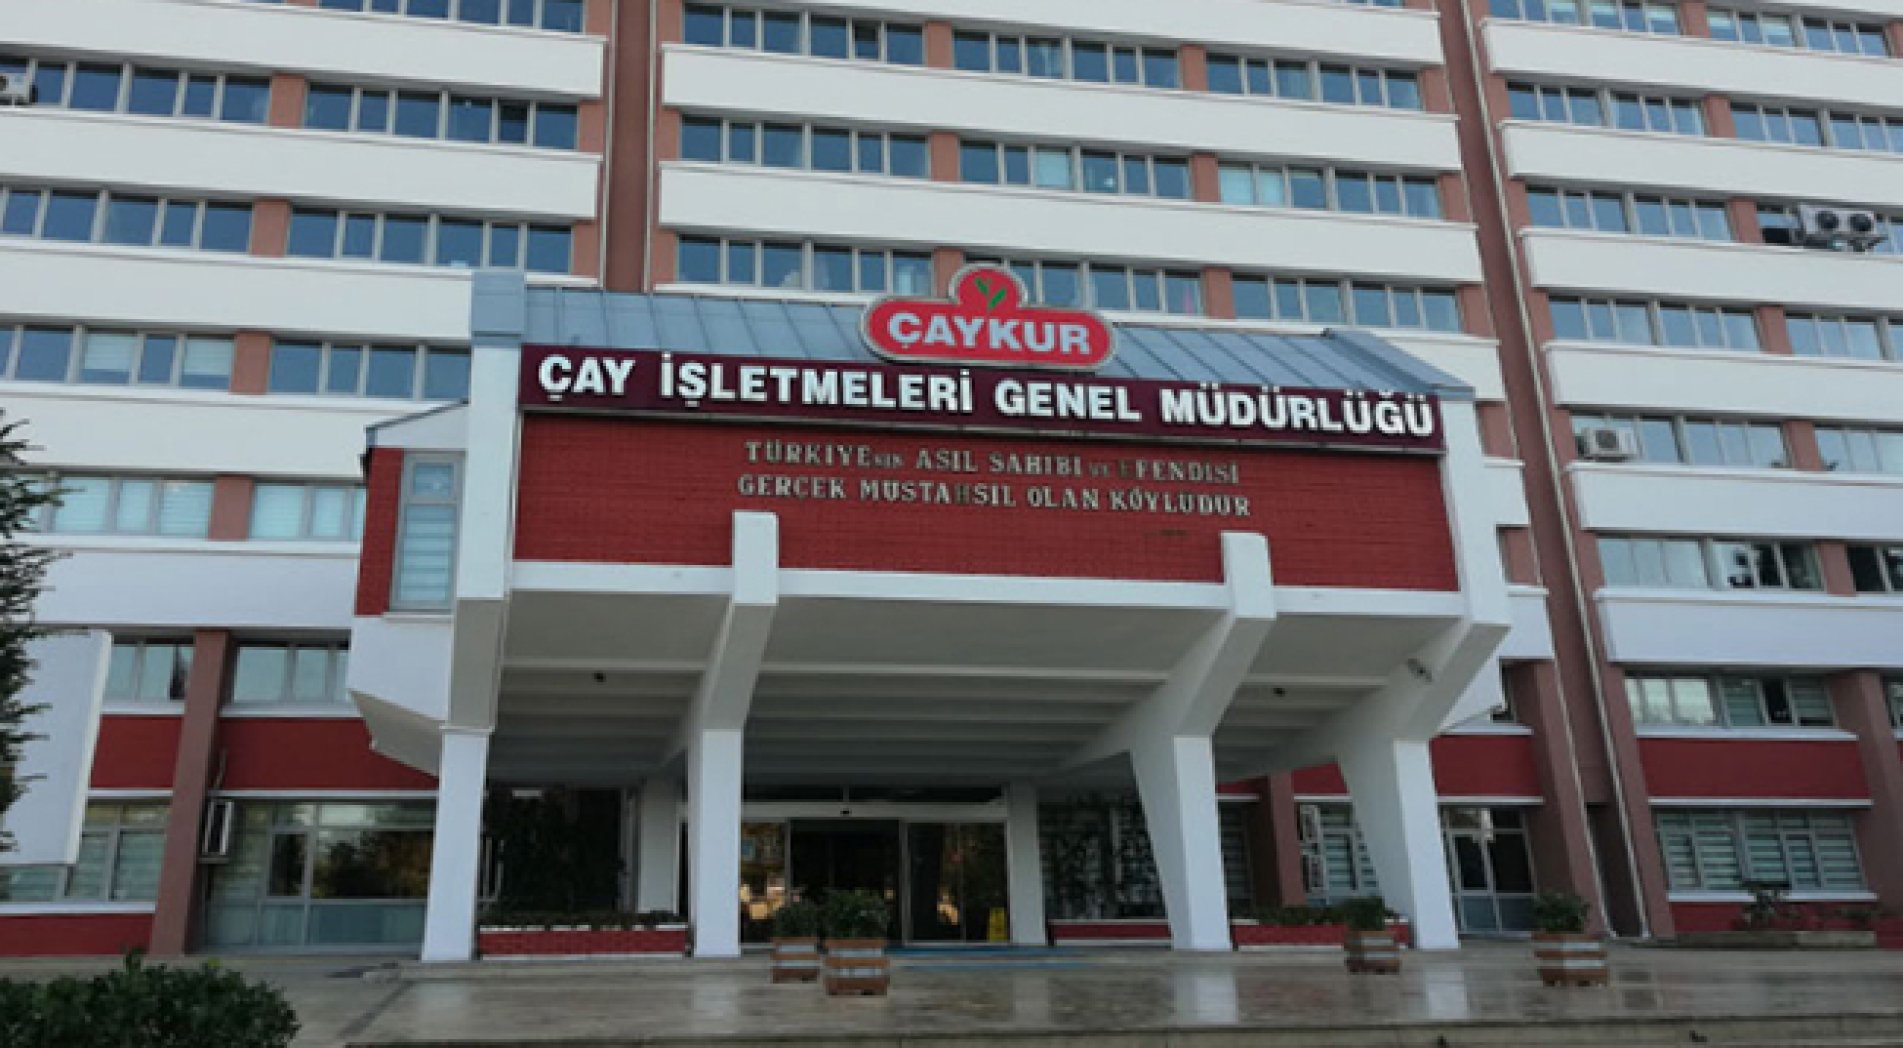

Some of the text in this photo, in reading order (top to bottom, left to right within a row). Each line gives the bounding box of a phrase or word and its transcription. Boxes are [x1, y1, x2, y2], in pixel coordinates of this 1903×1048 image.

[888, 312, 1092, 355] ÇAYKUR
[538, 351, 1434, 437] ÇAY İŞLETMELERİ GENEL MÜDÜRLÜĞÜ
[916, 448, 978, 472] ASIL
[1027, 485, 1099, 511] OLAN
